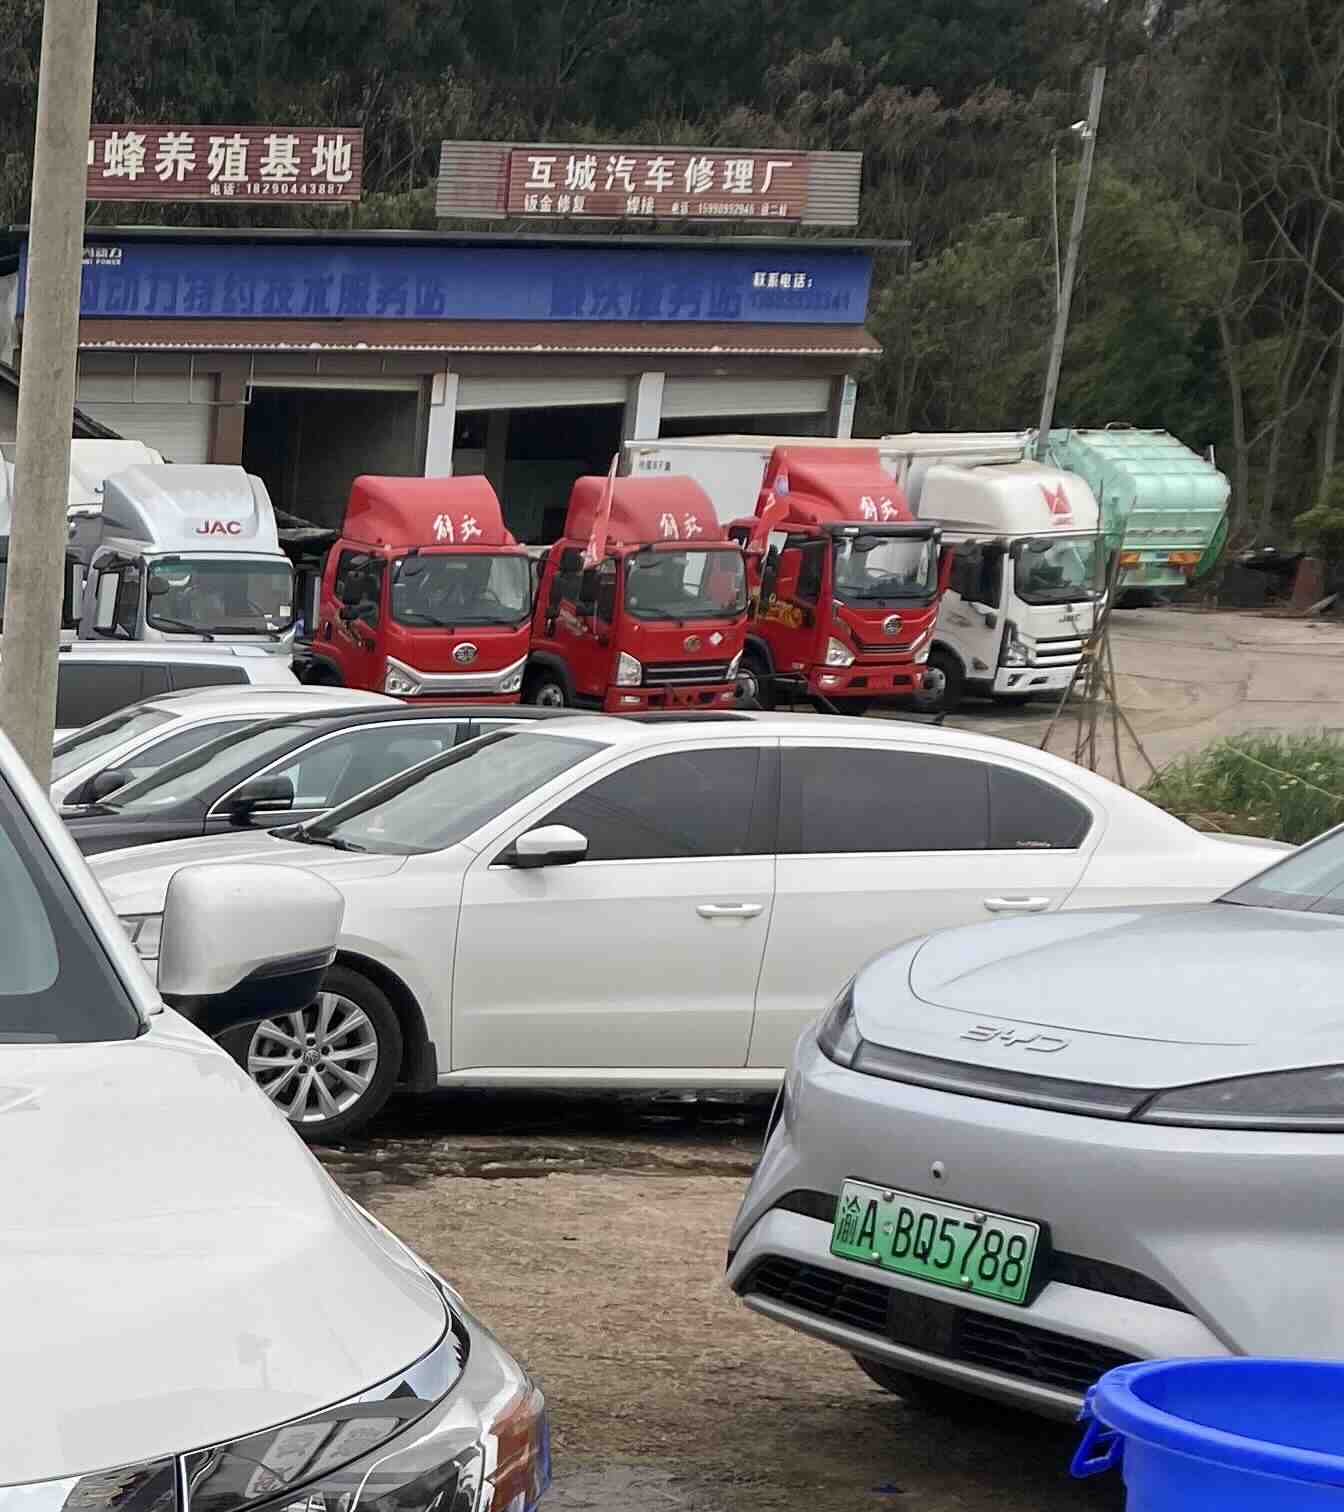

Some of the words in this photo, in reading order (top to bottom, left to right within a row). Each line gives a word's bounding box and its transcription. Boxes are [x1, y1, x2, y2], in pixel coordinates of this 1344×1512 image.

[524, 155, 793, 194] 互城汽车修理厂
[195, 519, 241, 535] JAC
[959, 1025, 1070, 1054] BYD
